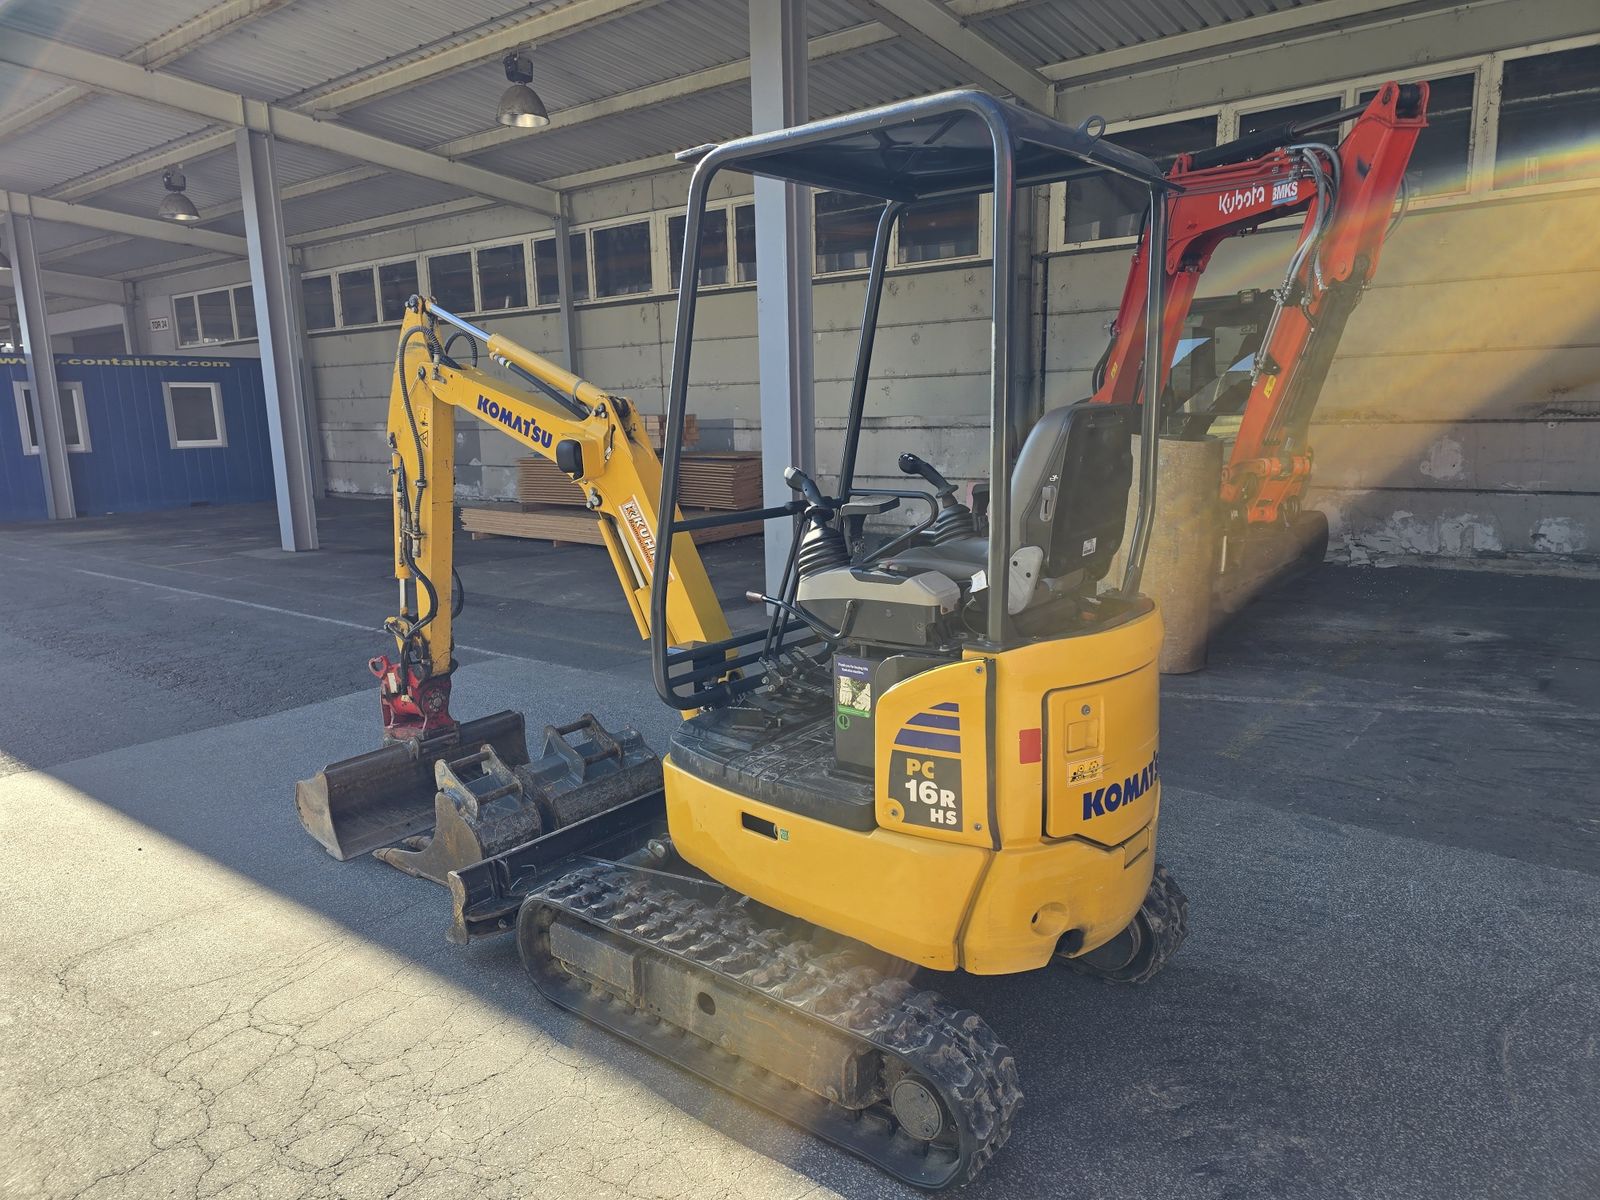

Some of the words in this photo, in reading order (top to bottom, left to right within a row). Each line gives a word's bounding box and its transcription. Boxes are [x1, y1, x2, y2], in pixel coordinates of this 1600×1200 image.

[1218, 183, 1265, 215] Kubota
[1272, 181, 1298, 201] BMKS
[477, 394, 553, 449] KOMATSU
[906, 757, 935, 779] PC
[905, 778, 957, 809] 16R
[930, 807, 958, 826] HS
